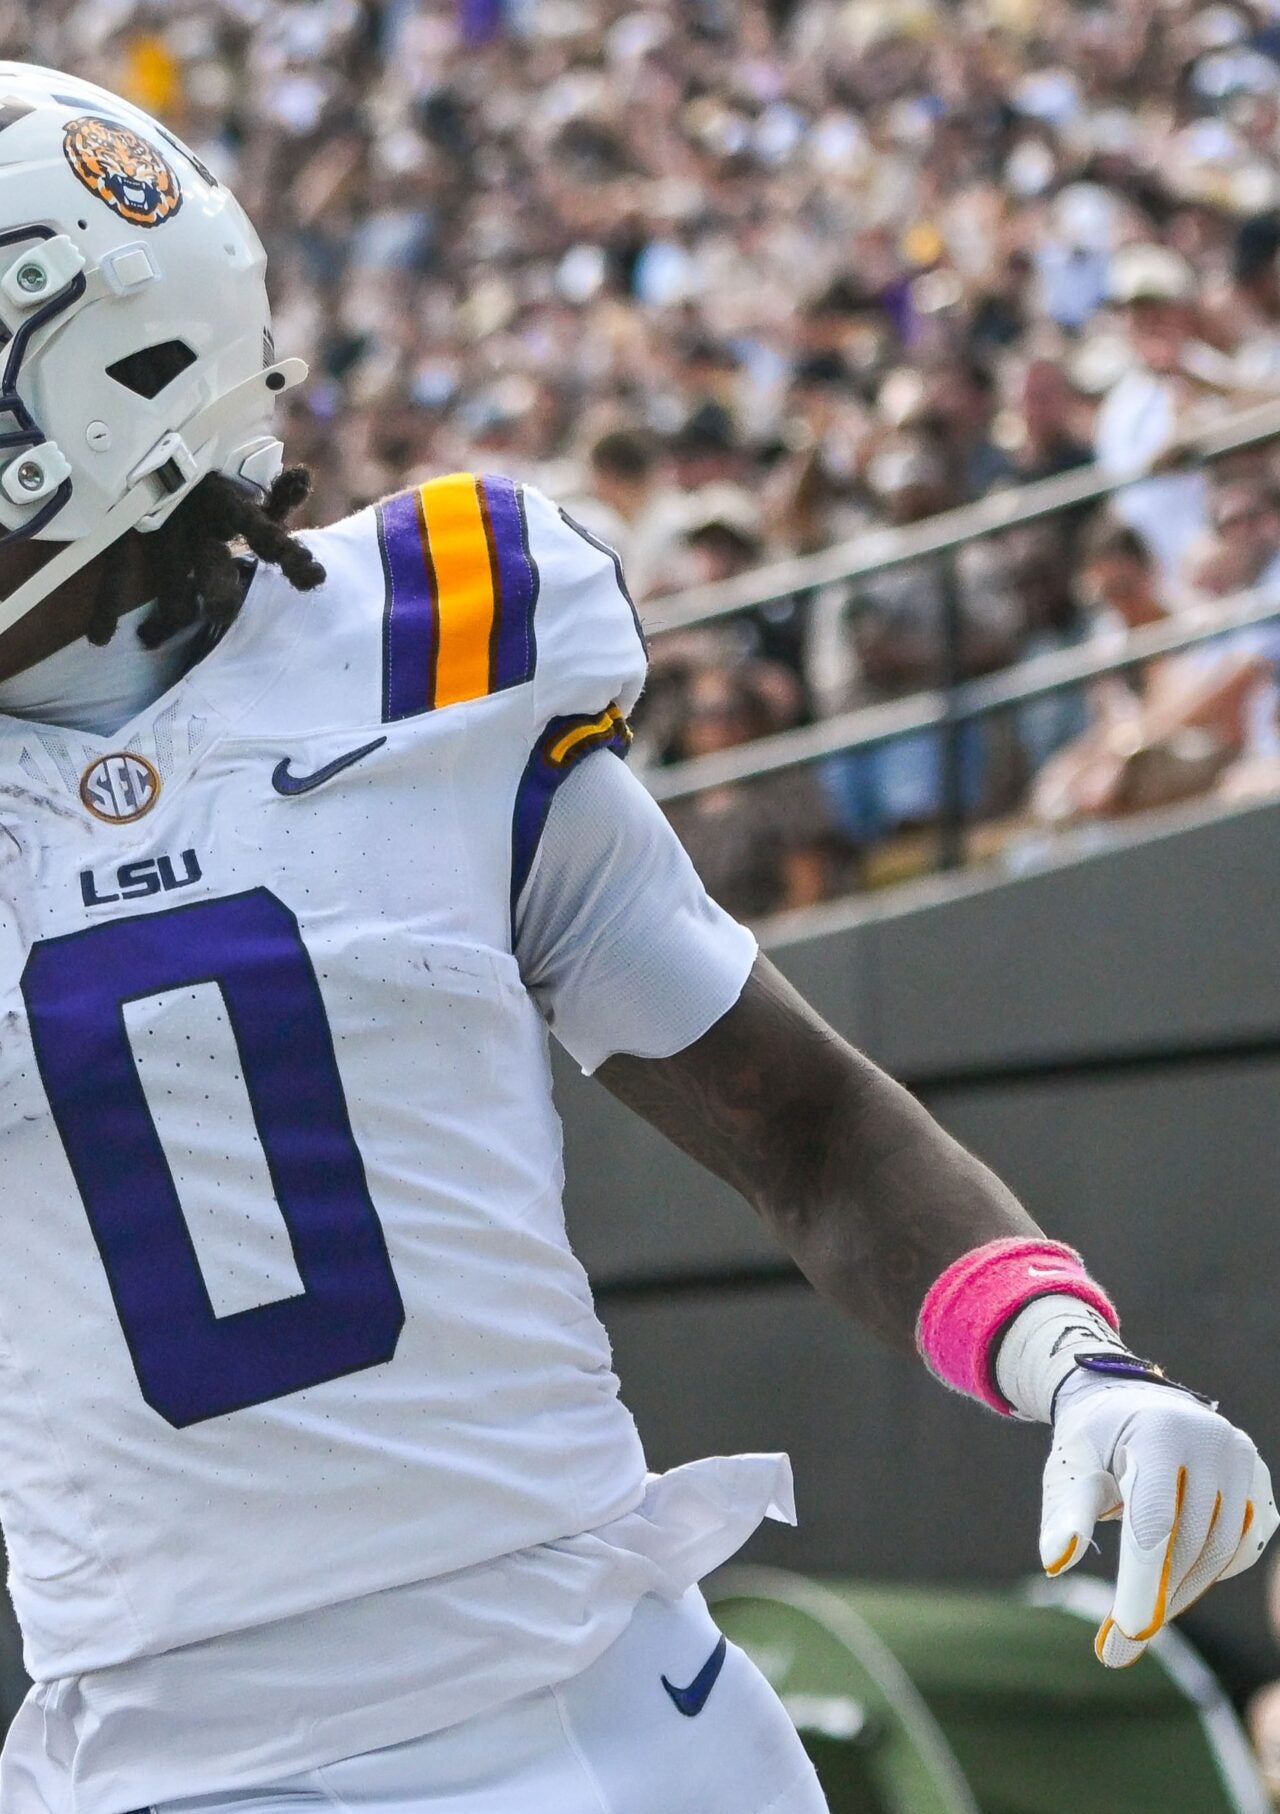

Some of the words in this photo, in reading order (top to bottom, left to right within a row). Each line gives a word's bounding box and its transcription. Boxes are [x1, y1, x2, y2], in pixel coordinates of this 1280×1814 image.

[85, 755, 155, 819] SEC
[79, 848, 203, 908] LSU
[19, 886, 406, 1429] 0
